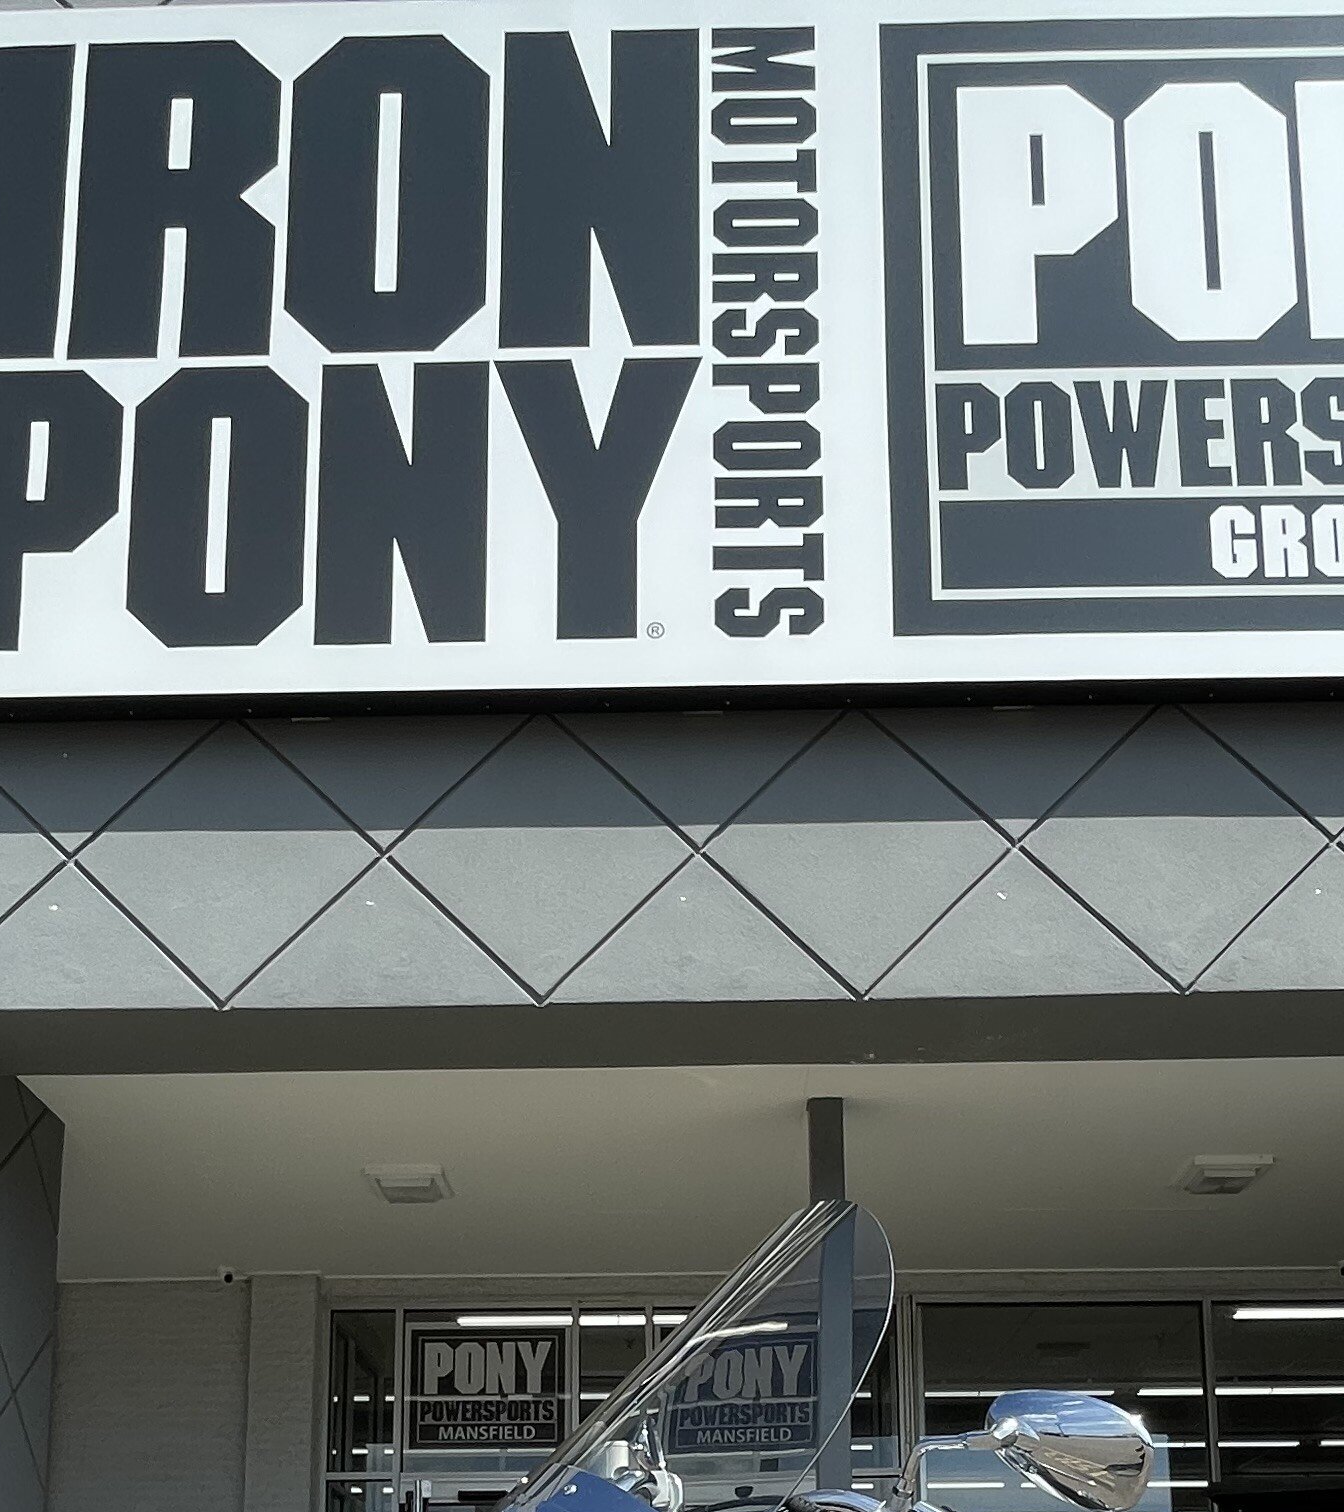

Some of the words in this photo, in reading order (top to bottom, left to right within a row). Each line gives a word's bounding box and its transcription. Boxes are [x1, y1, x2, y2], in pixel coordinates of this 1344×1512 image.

[710, 26, 826, 638] MOTORSPORTS
[423, 1341, 553, 1395] PONY
[683, 1344, 809, 1402] PONY
[419, 1400, 554, 1422] POWERSPORTS
[678, 1402, 810, 1427] POWERSPORTS
[438, 1425, 536, 1441] MANSFIELD
[696, 1427, 792, 1445] MANSFIELD
